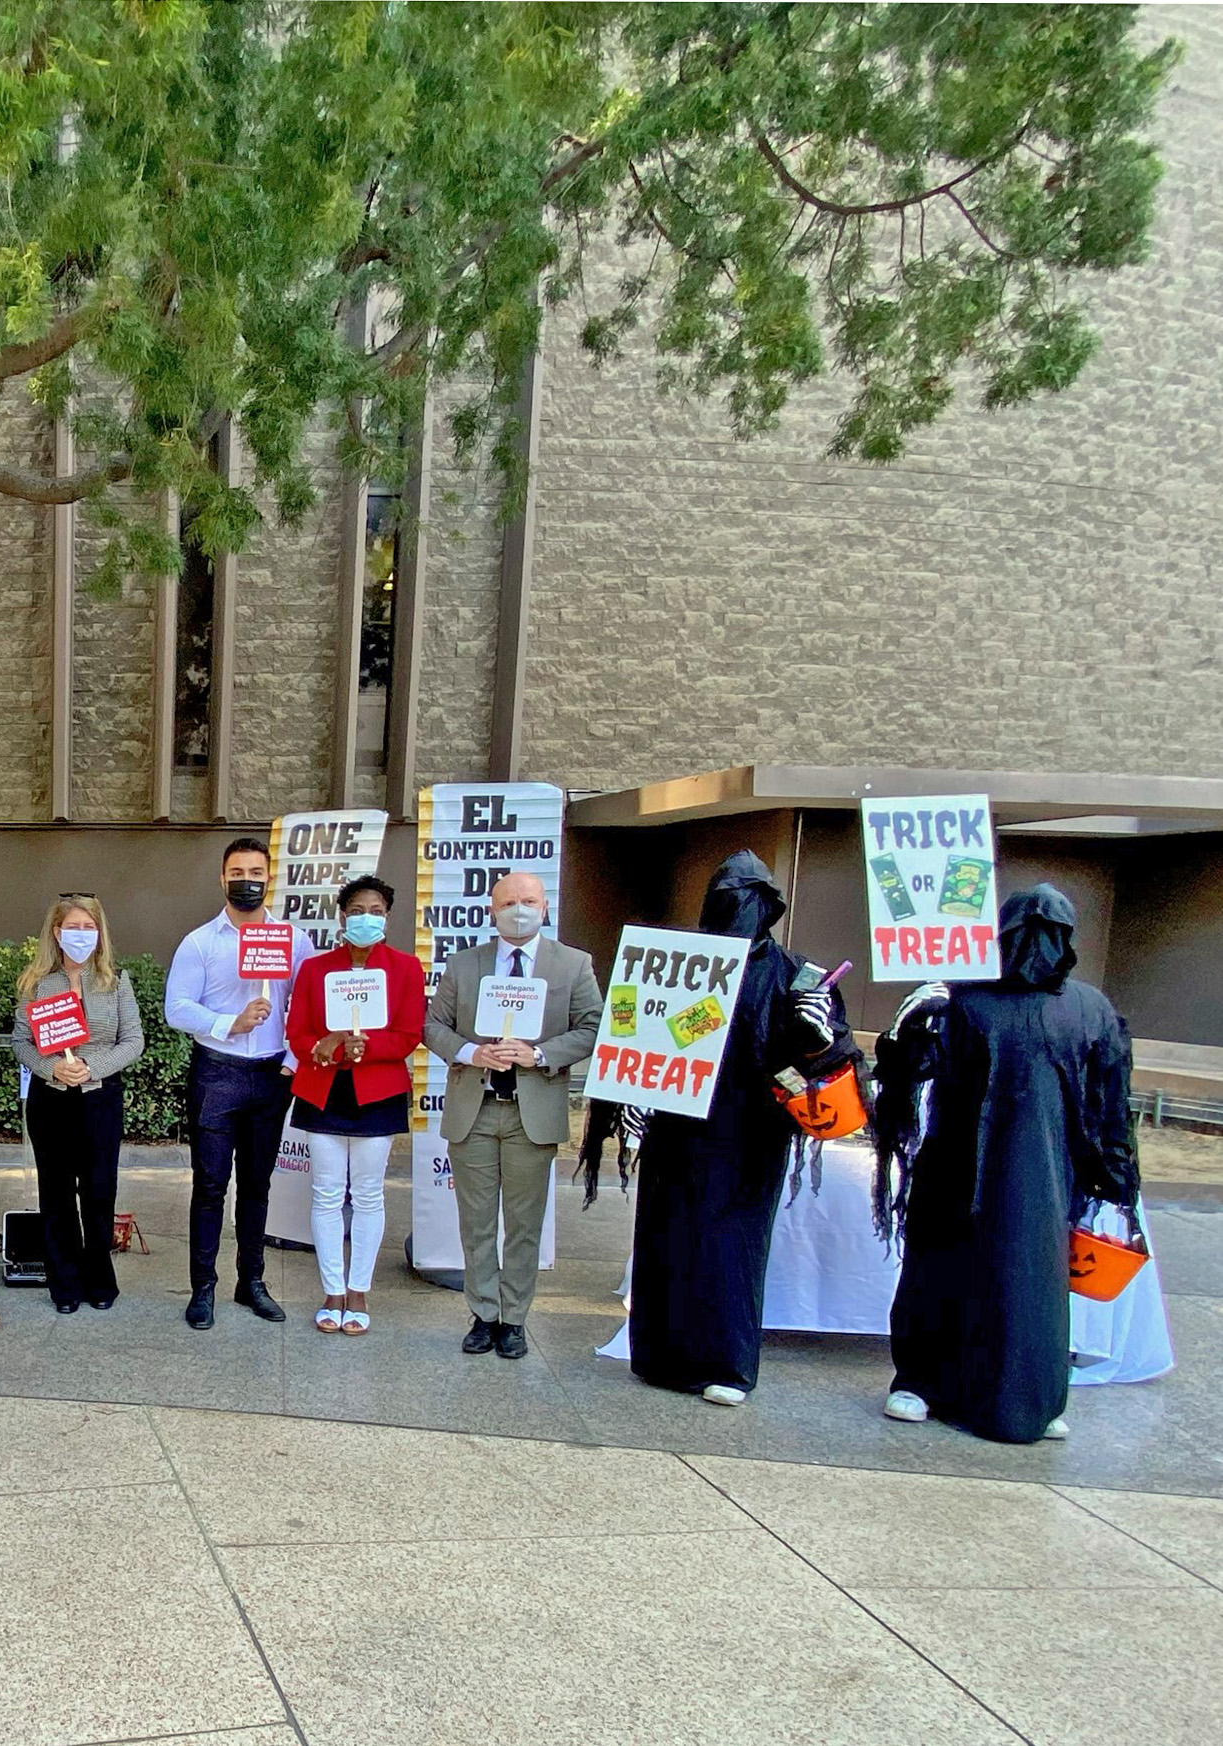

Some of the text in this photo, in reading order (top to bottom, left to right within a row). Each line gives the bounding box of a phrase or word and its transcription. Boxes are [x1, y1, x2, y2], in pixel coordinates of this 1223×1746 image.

[461, 795, 517, 833] EL
[287, 821, 363, 856] ONE
[868, 809, 985, 850] TRICK
[423, 839, 555, 861] CONTENIDO
[286, 862, 350, 886] VAPE
[912, 874, 935, 892] OR
[874, 925, 994, 966] TREAT
[622, 945, 739, 996] TRICK
[343, 992, 368, 1003] .org
[497, 999, 525, 1011] .org
[509, 992, 539, 1000] tobacco
[644, 999, 668, 1018] OR
[39, 1023, 50, 1032] All
[39, 1031, 50, 1040] All
[597, 1043, 714, 1097] TREAT
[279, 1140, 310, 1158] GANS
[275, 1156, 310, 1173] OBACCO
[433, 1157, 451, 1174] SA
